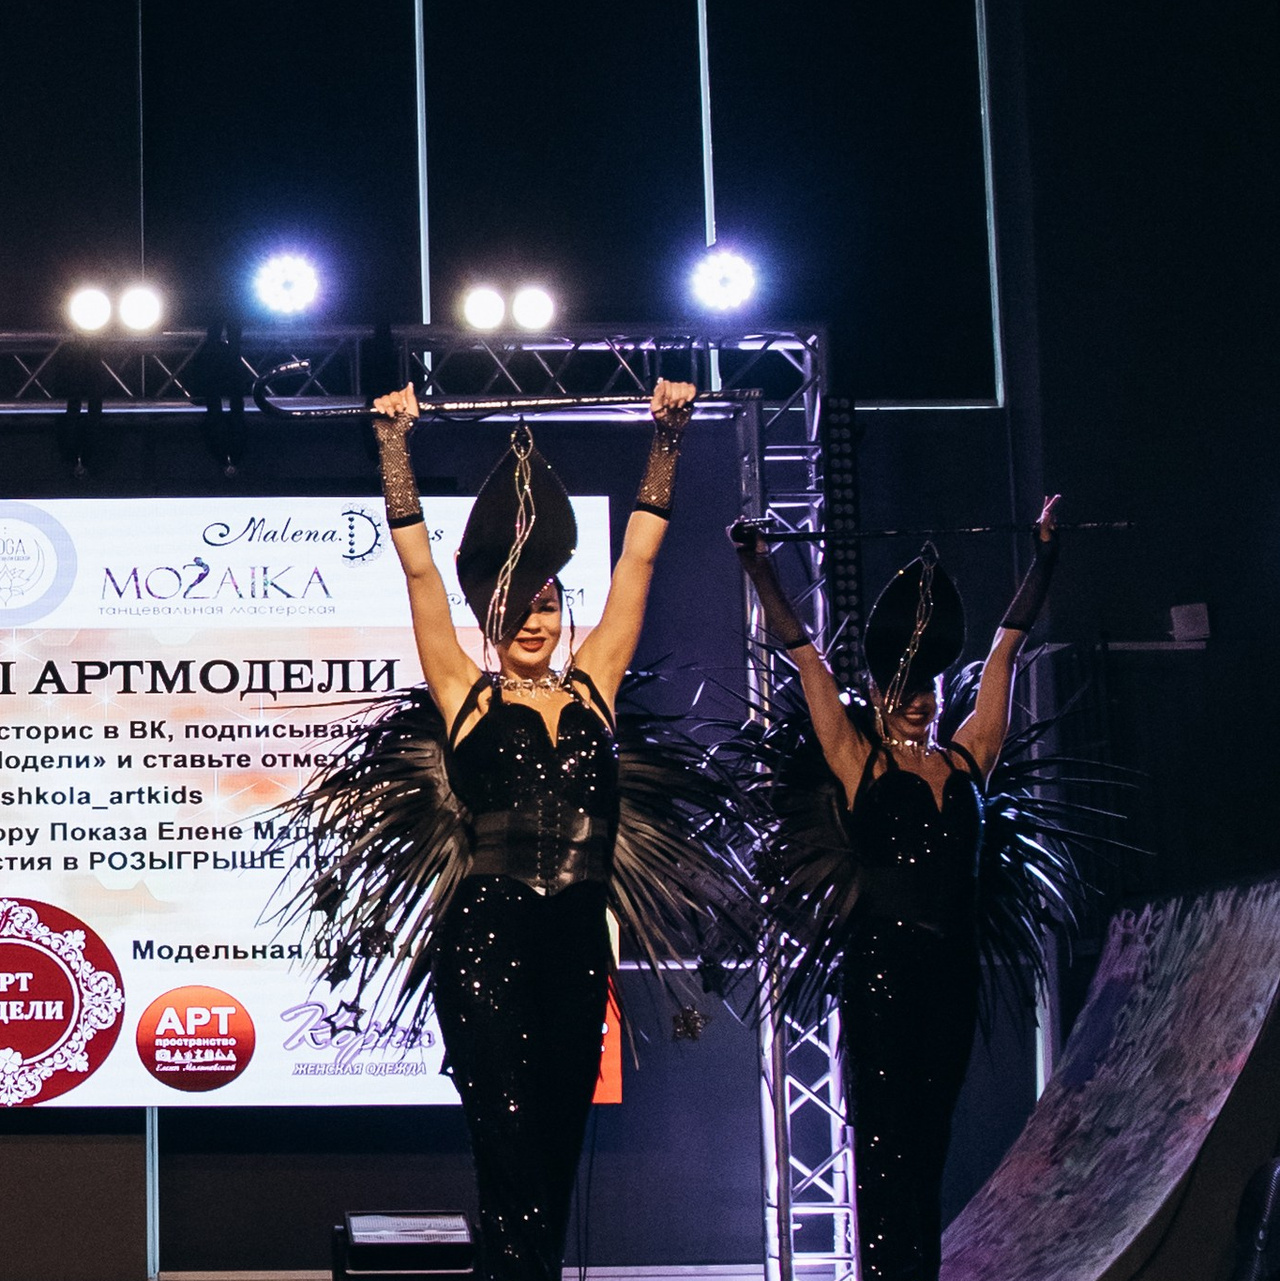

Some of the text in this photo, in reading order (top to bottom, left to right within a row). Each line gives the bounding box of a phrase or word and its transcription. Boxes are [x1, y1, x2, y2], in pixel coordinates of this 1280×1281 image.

[98, 605, 336, 617] танцевальная мастерская
[28, 659, 401, 702] АРТМОДЕЛИ
[104, 725, 119, 739] в
[130, 721, 174, 742] ВК,
[185, 720, 370, 742] подписывай
[118, 755, 132, 769] и
[143, 753, 251, 769] ставьте
[1, 786, 204, 810] shkola_artkids
[50, 823, 147, 842] Показа
[158, 821, 244, 841] Елене
[63, 856, 79, 871] в
[89, 850, 286, 871] РОЗЫГРЫШЕ
[132, 939, 303, 963] Модельная
[154, 1006, 237, 1036] АРТ
[155, 1037, 237, 1048] пространство
[291, 1062, 428, 1077] ЖЕНСКАЯ ОДЕЖДА
